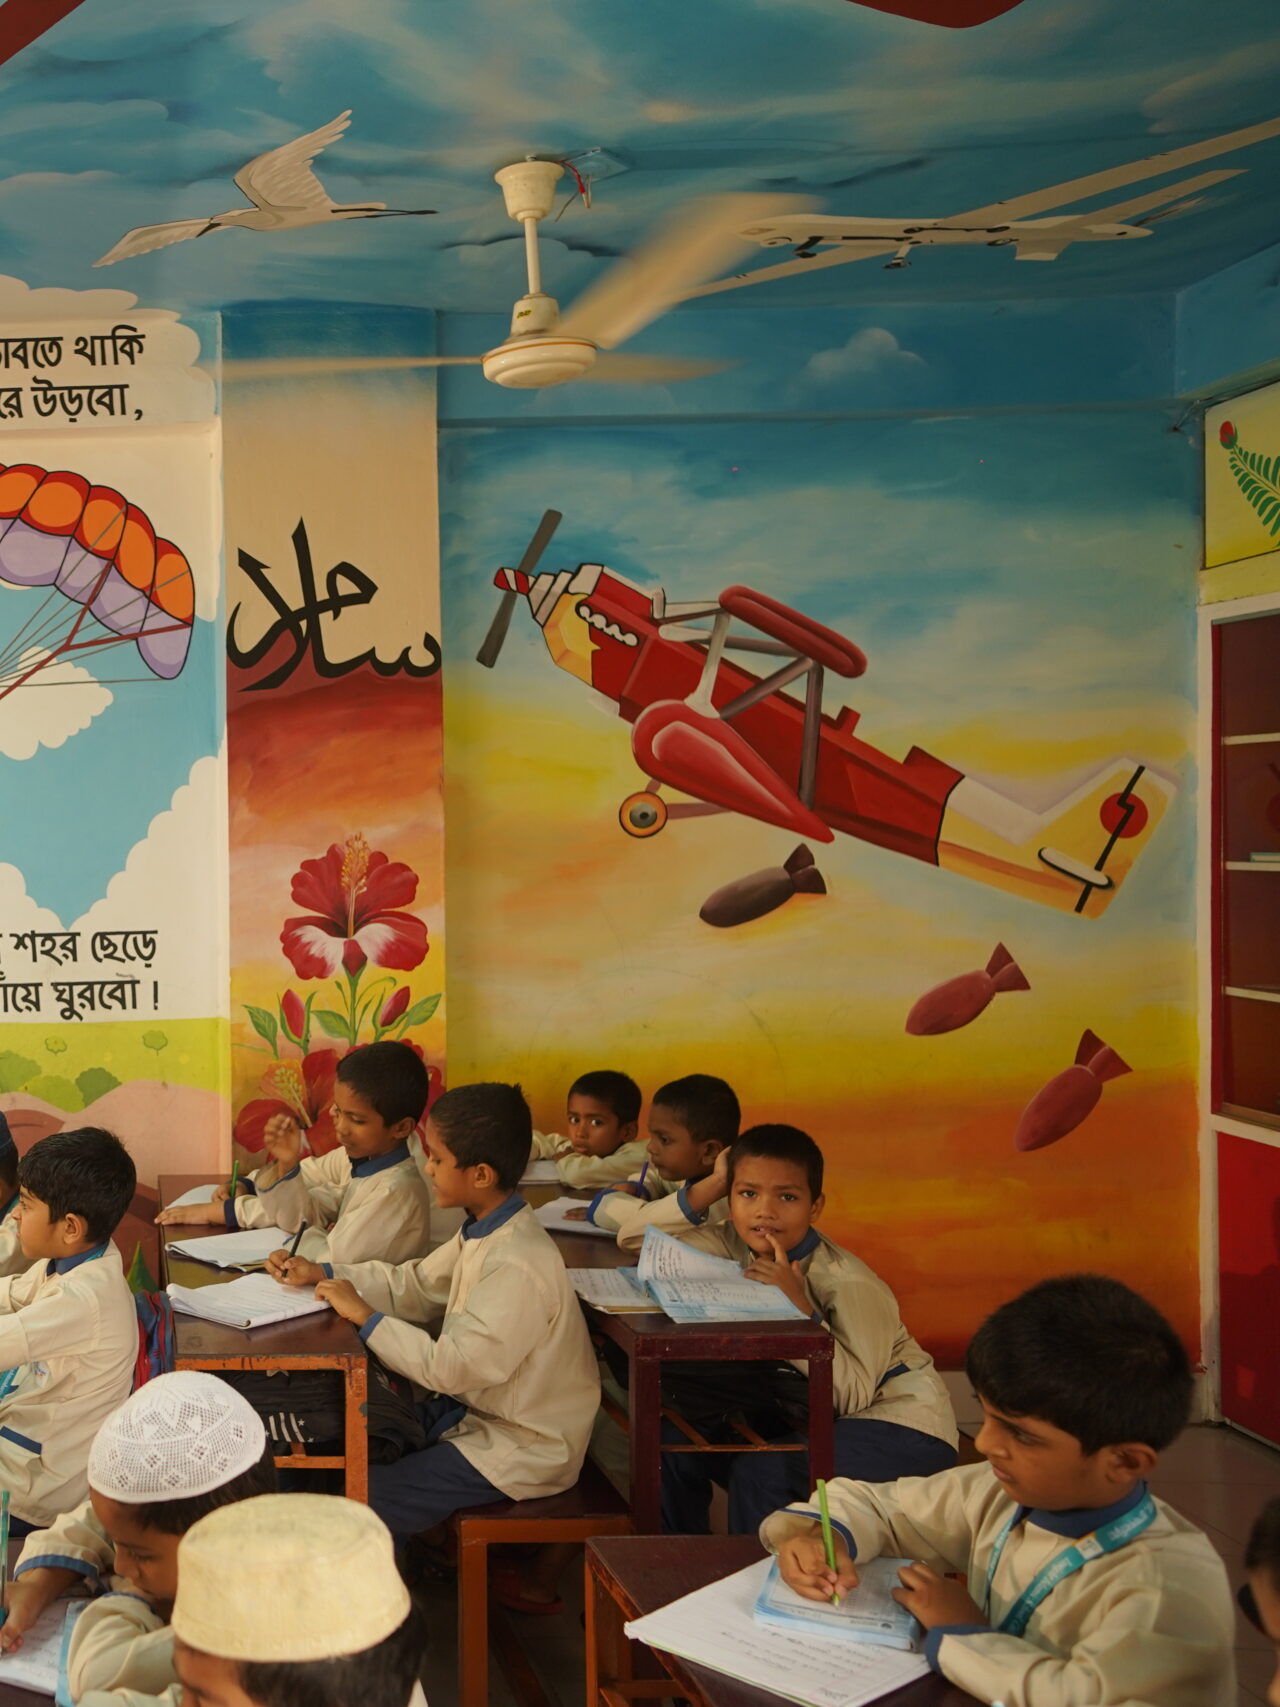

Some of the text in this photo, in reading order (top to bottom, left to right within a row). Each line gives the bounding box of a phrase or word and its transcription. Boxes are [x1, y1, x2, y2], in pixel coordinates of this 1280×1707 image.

[74, 324, 146, 366] থাকি
[10, 930, 81, 965] শহর
[91, 930, 158, 968] ছেড়ে
